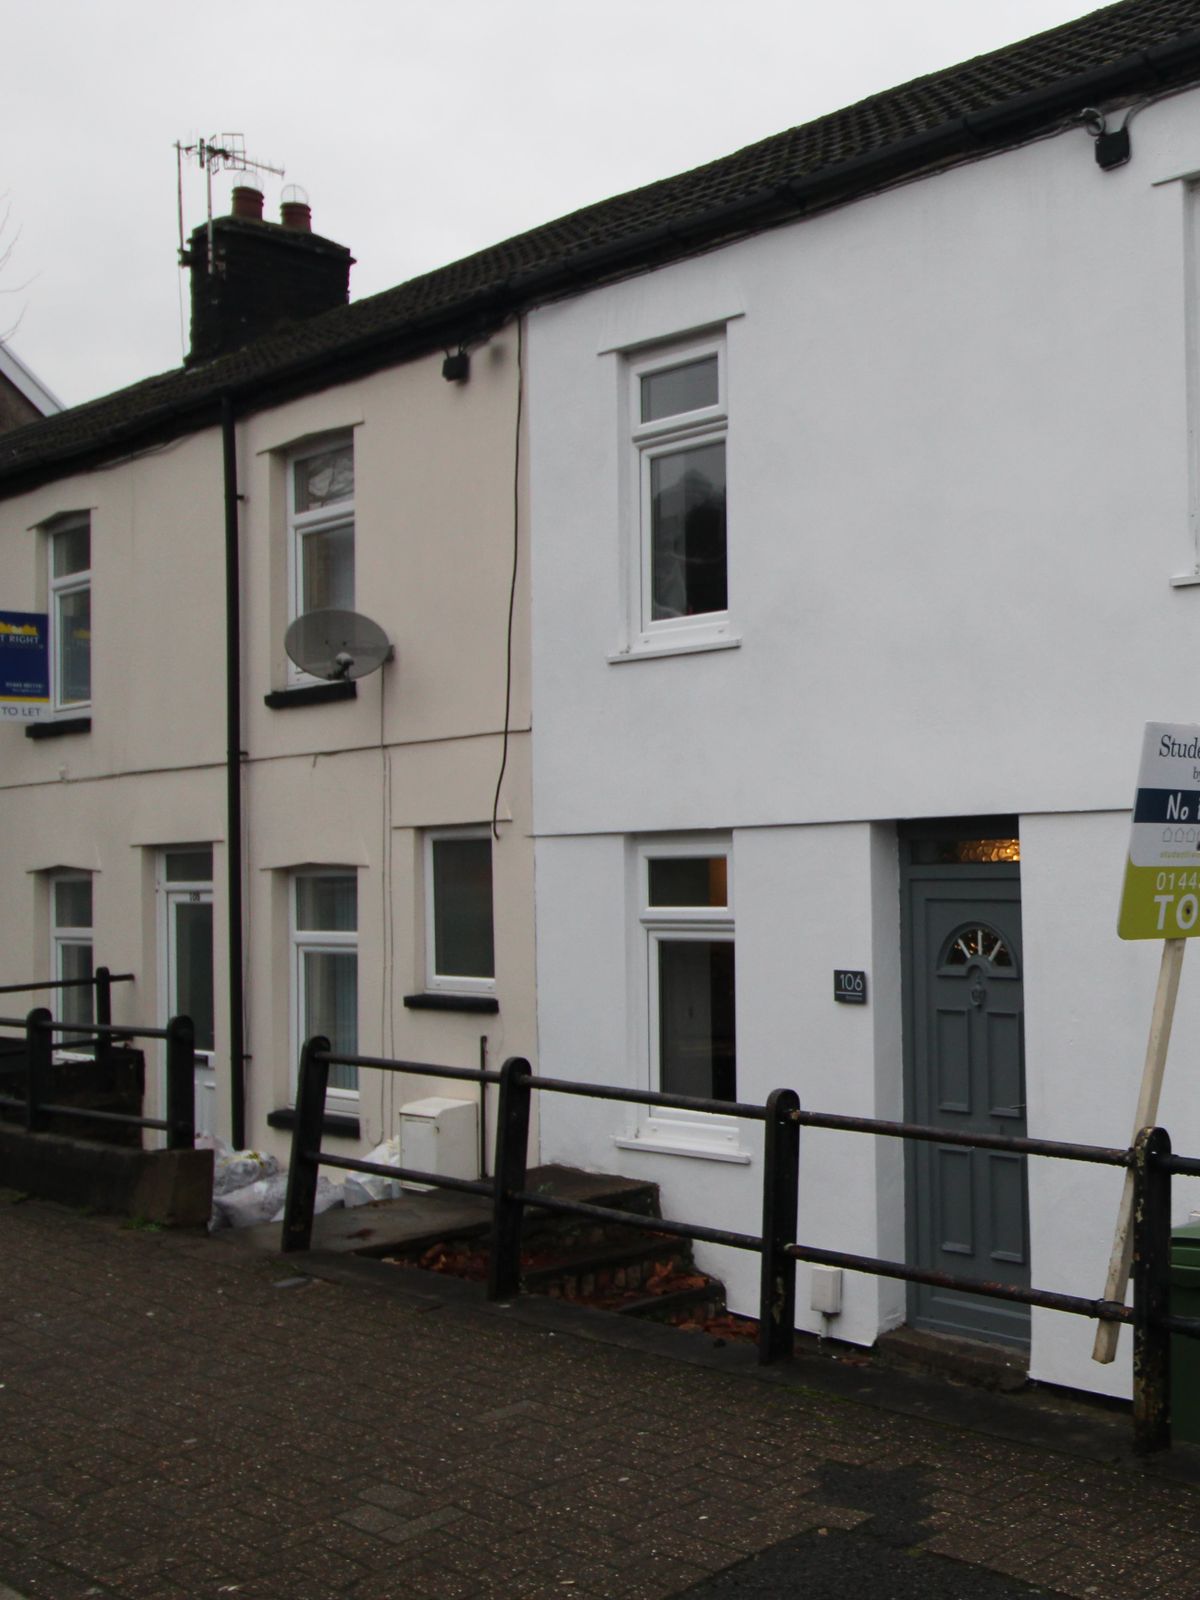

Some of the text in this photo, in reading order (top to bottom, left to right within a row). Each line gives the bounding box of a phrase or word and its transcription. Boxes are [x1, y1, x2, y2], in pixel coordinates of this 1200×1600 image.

[9, 634, 39, 644] RIGHT
[1, 706, 40, 717] TO LET
[1166, 792, 1189, 821] No
[1154, 893, 1199, 930] TO
[840, 974, 863, 991] 106
